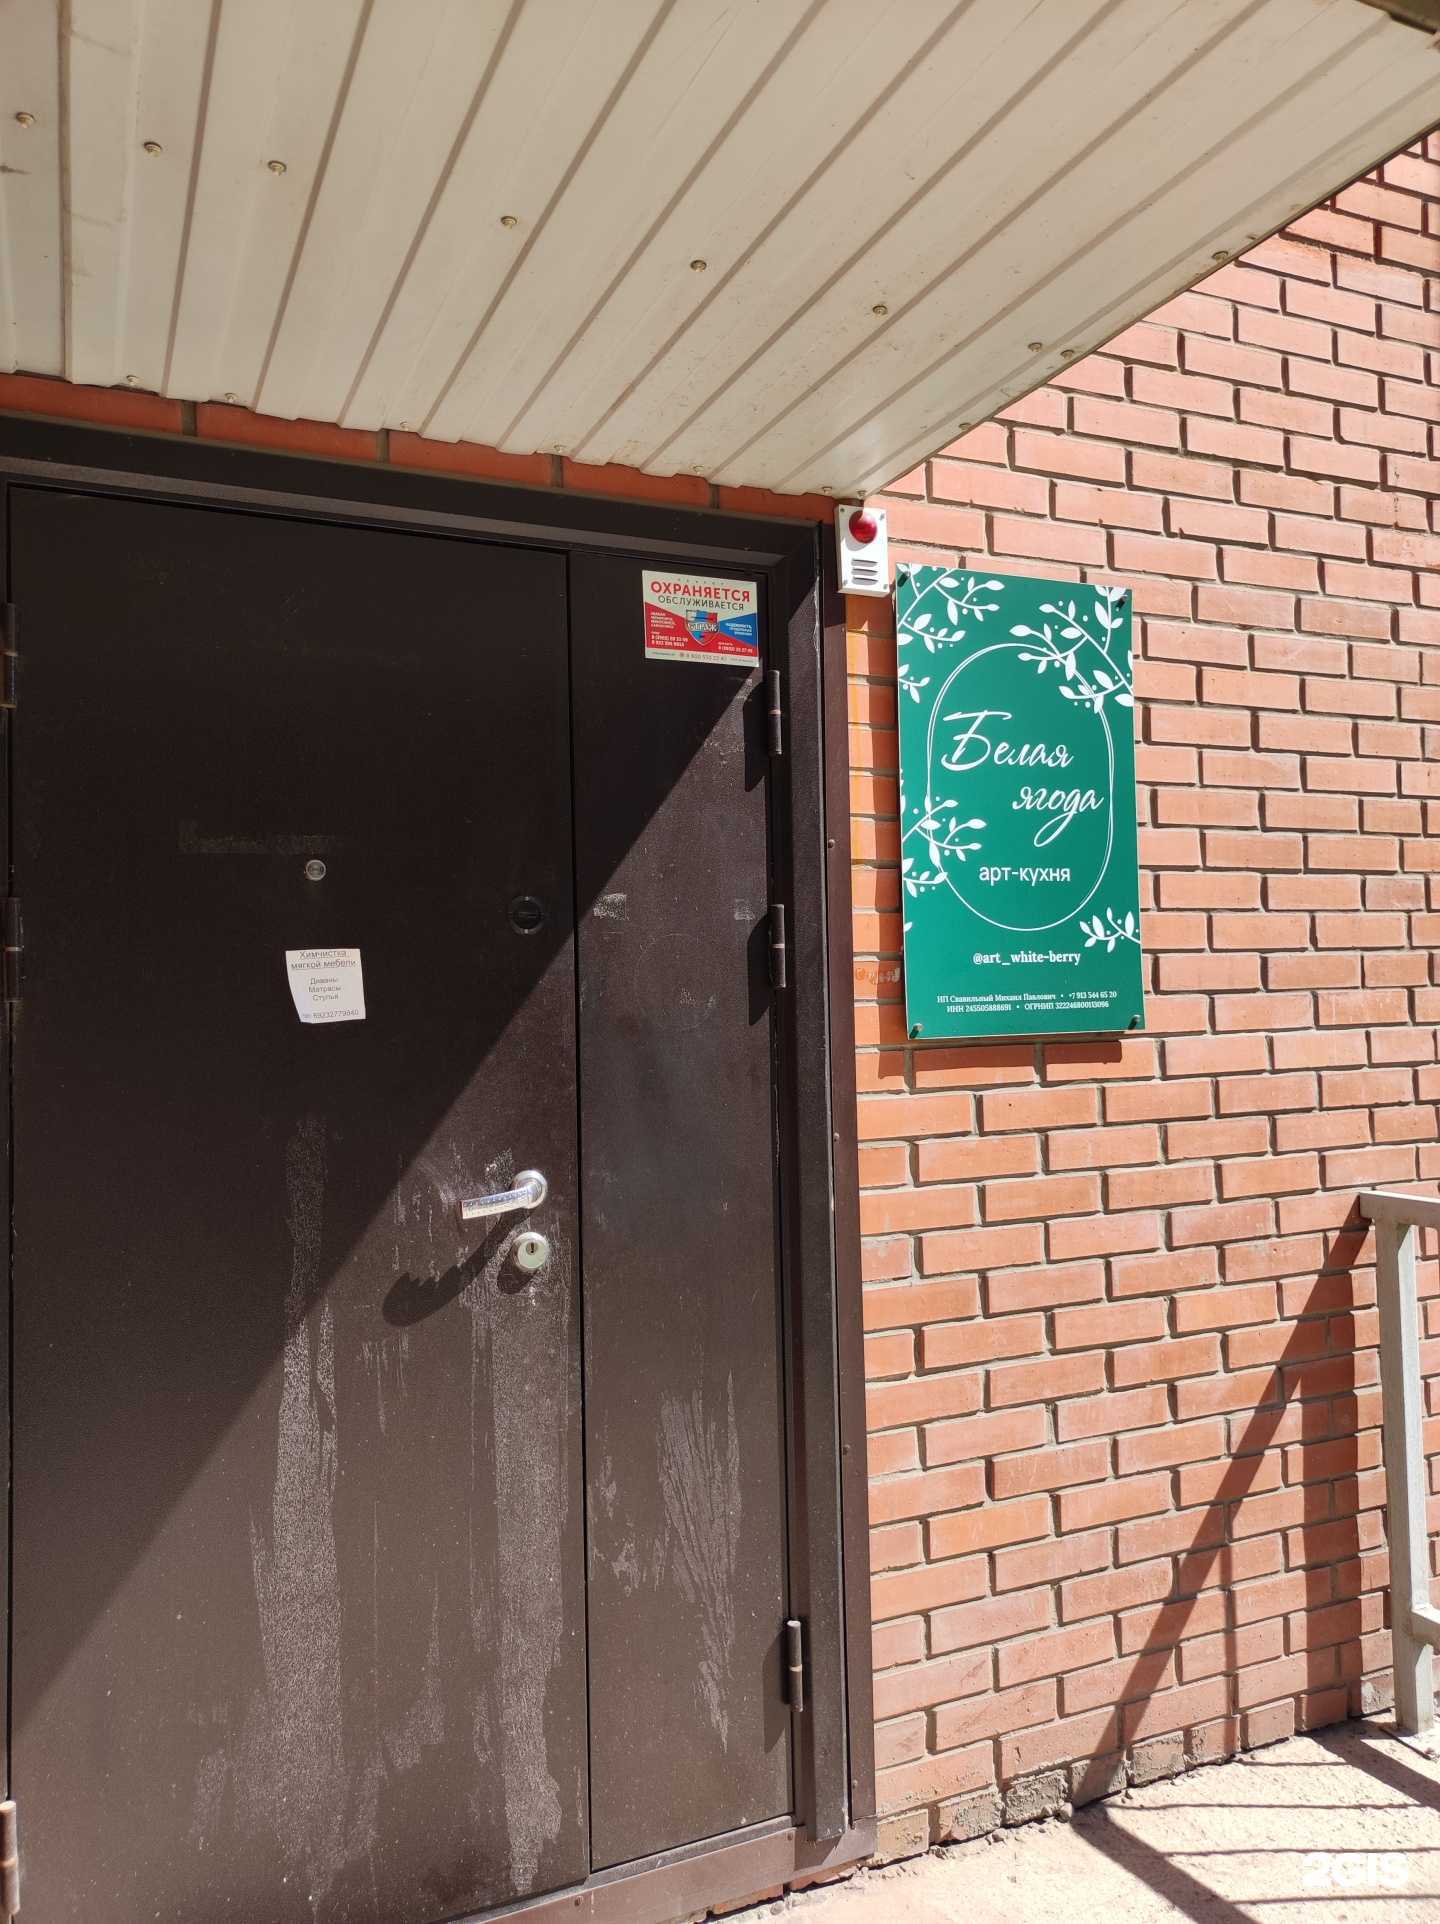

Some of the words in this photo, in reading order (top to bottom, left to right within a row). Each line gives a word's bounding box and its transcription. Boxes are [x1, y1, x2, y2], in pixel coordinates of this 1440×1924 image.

[650, 580, 751, 603] ОХРАНЯЕТСЯ
[657, 594, 744, 611] ОБСЛУЖИВАЕТСЯ
[940, 710, 1075, 772] Белая
[1011, 786, 1105, 848] ягода
[978, 866, 1072, 886] арт-кухня
[947, 1004, 964, 1013] ИНН
